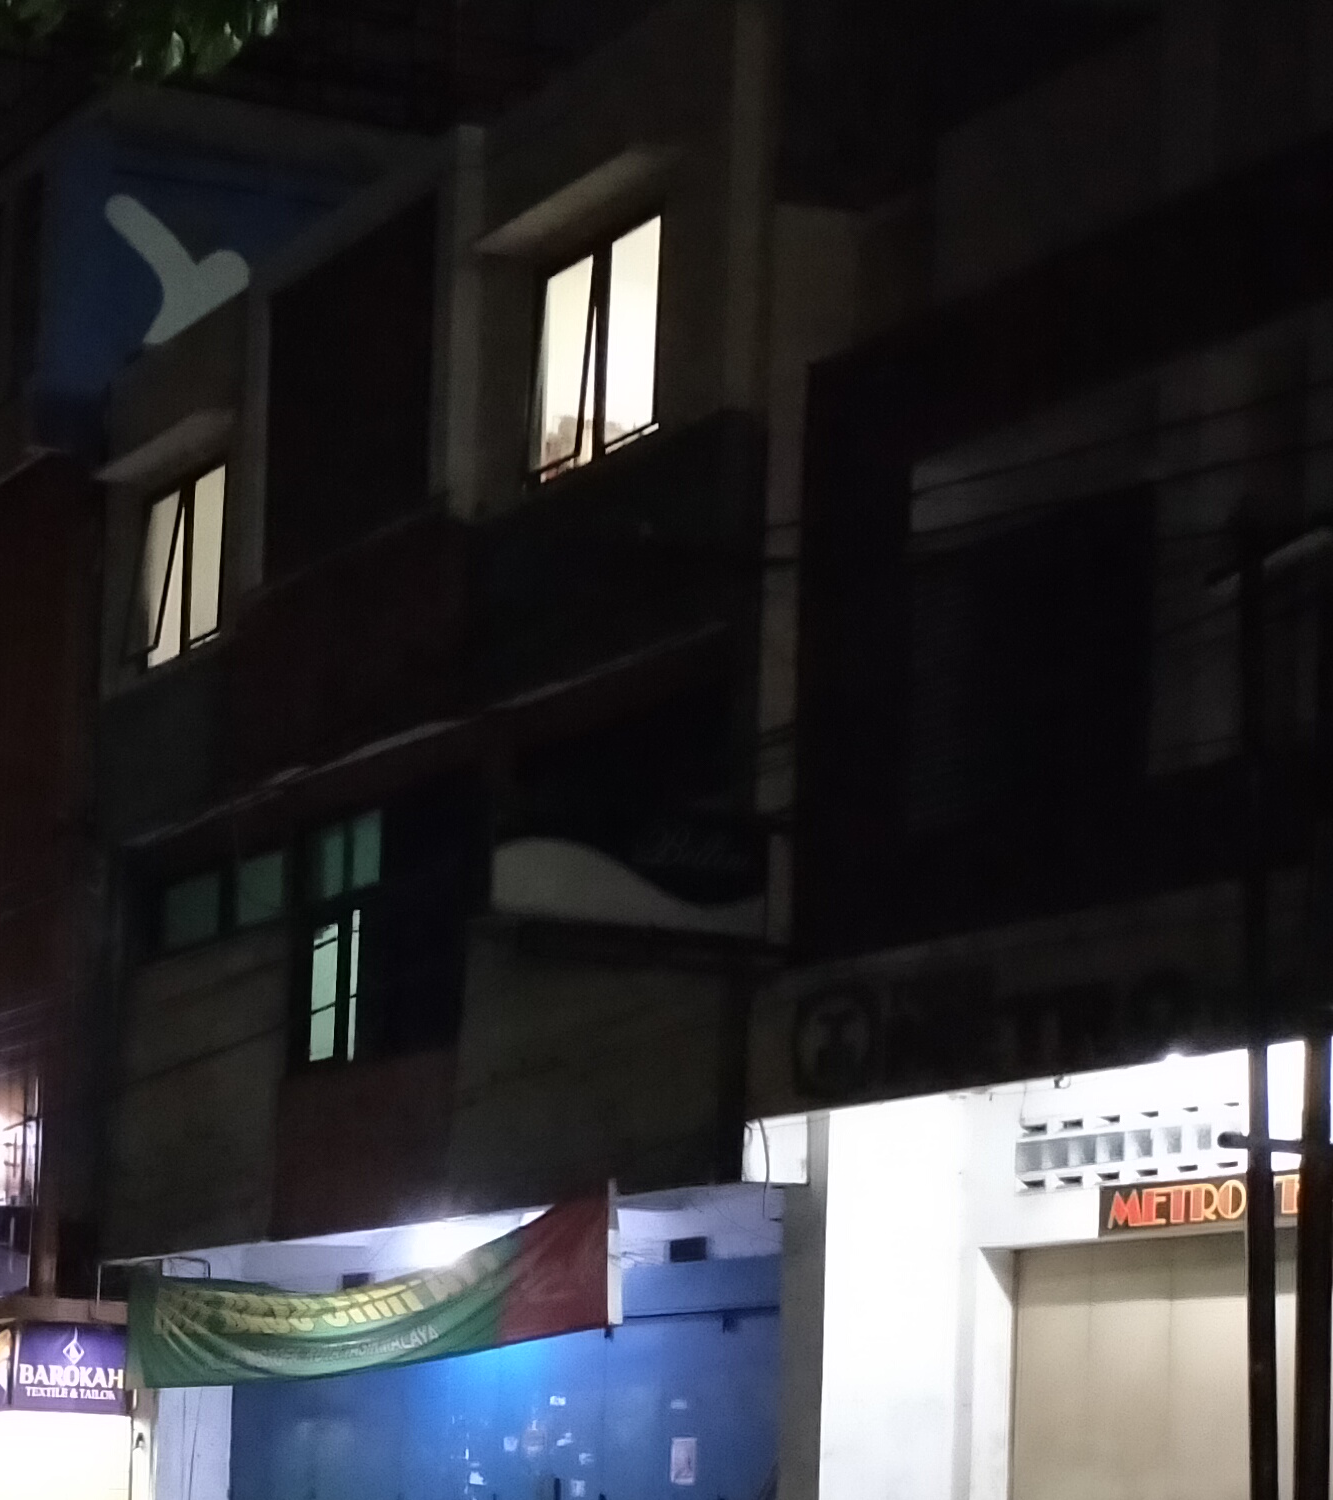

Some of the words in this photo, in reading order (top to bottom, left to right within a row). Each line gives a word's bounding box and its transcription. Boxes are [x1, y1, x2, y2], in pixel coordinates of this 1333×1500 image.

[1107, 1179, 1247, 1229] METRO
[19, 1363, 124, 1390] BAROKAH
[26, 1386, 68, 1400] TEXTILE
[69, 1388, 79, 1399] &
[80, 1387, 116, 1400] TAILOR
